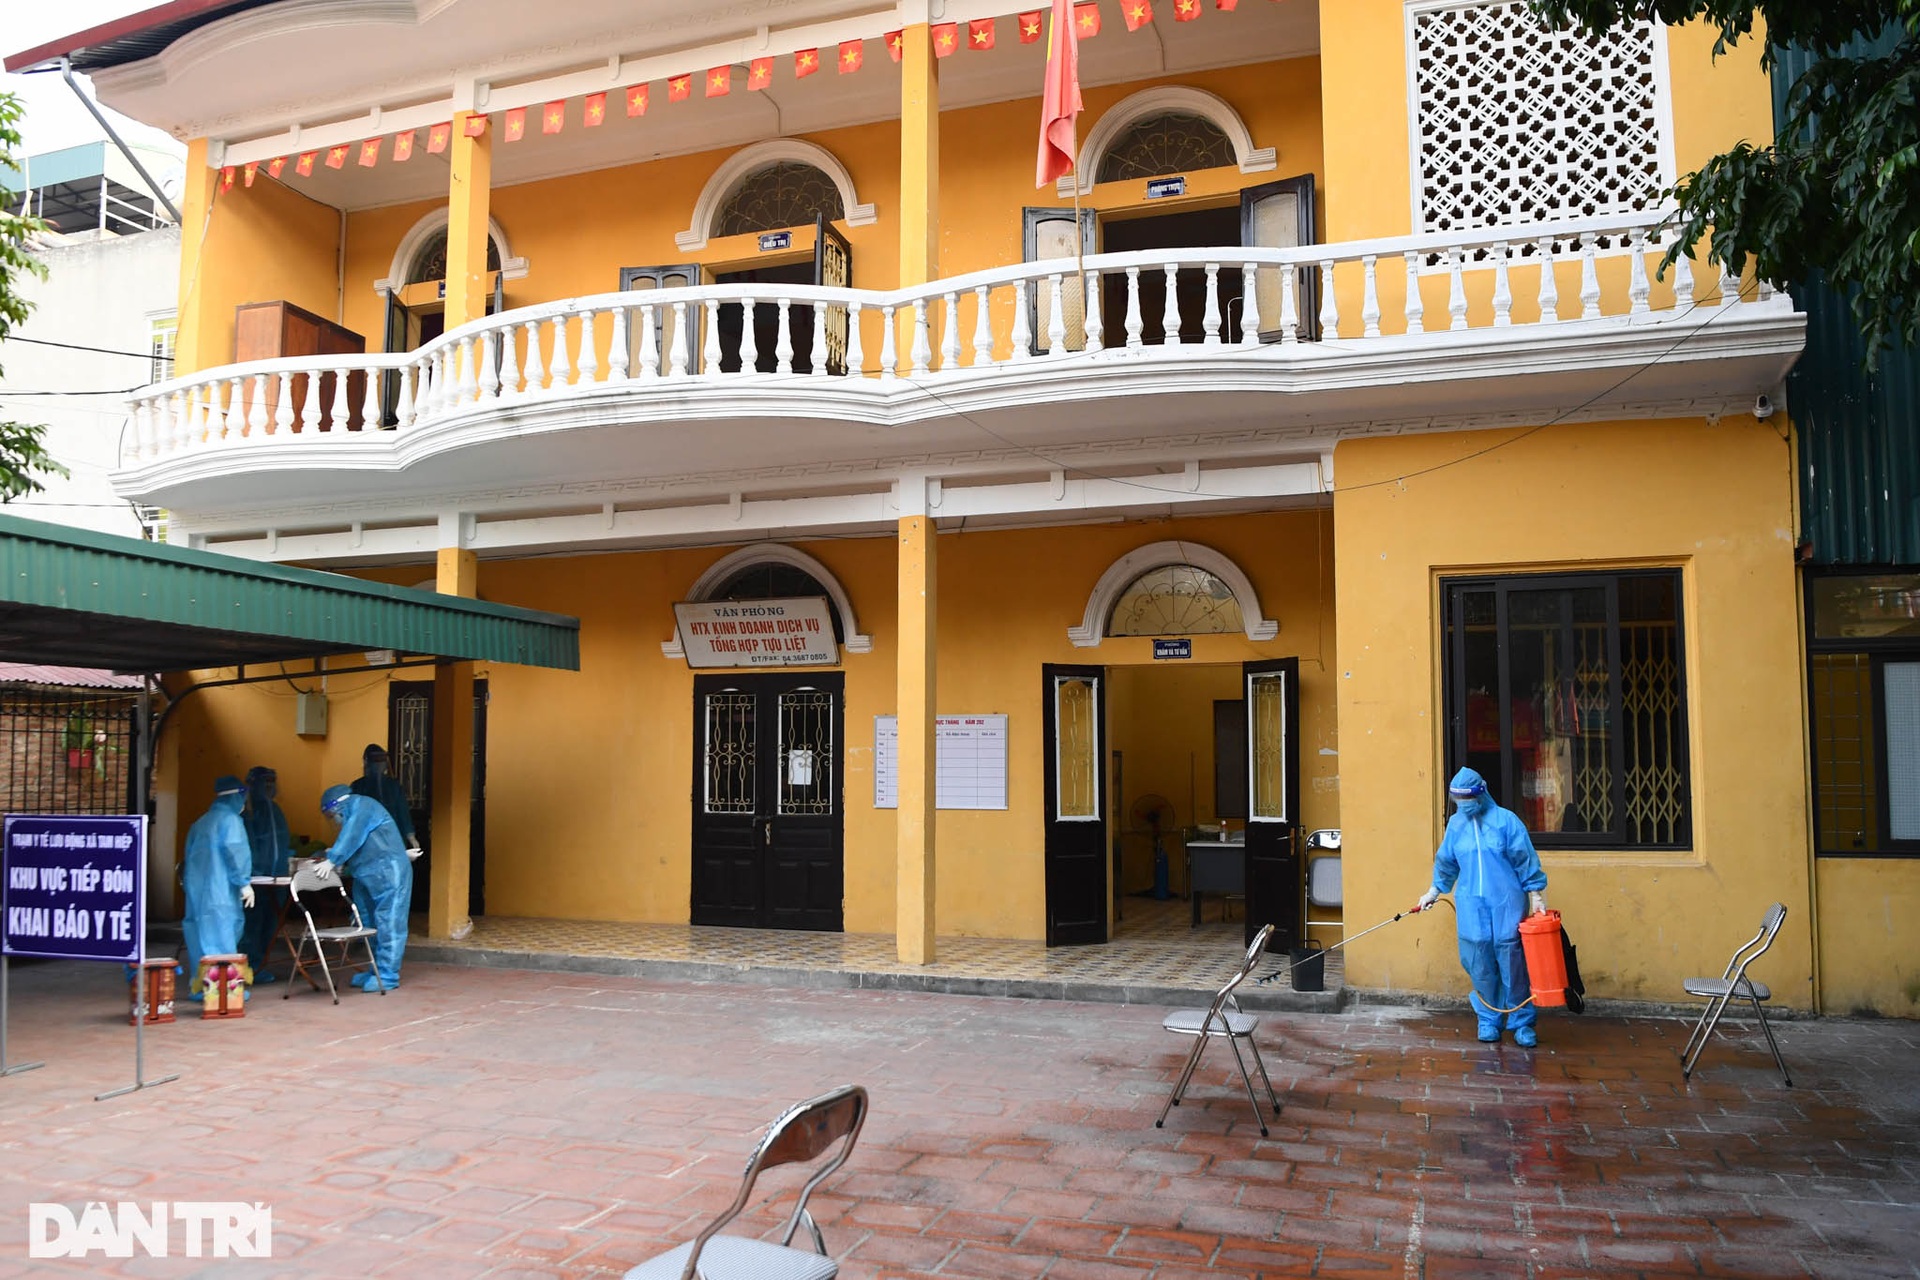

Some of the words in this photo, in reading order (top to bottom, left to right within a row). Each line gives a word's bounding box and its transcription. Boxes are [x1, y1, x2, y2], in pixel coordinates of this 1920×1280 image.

[714, 607, 739, 617] VĂN
[742, 605, 785, 617] PHÒNG
[690, 622, 711, 635] HTX
[712, 621, 738, 635] KINH
[738, 620, 775, 634] DOANH
[776, 619, 803, 636] DỊCH
[804, 618, 820, 635] VỤ
[709, 635, 737, 653] TỔNG
[738, 638, 759, 654] HỢP
[785, 636, 807, 653] LIỆT
[10, 866, 38, 890] KHU
[40, 866, 67, 896] VỰC
[70, 862, 101, 892] TIẾP
[103, 865, 133, 893] ĐÓN
[9, 906, 49, 937] KHAI
[53, 903, 90, 939] BÁO
[94, 910, 106, 940] Y
[109, 902, 133, 940] TẾ
